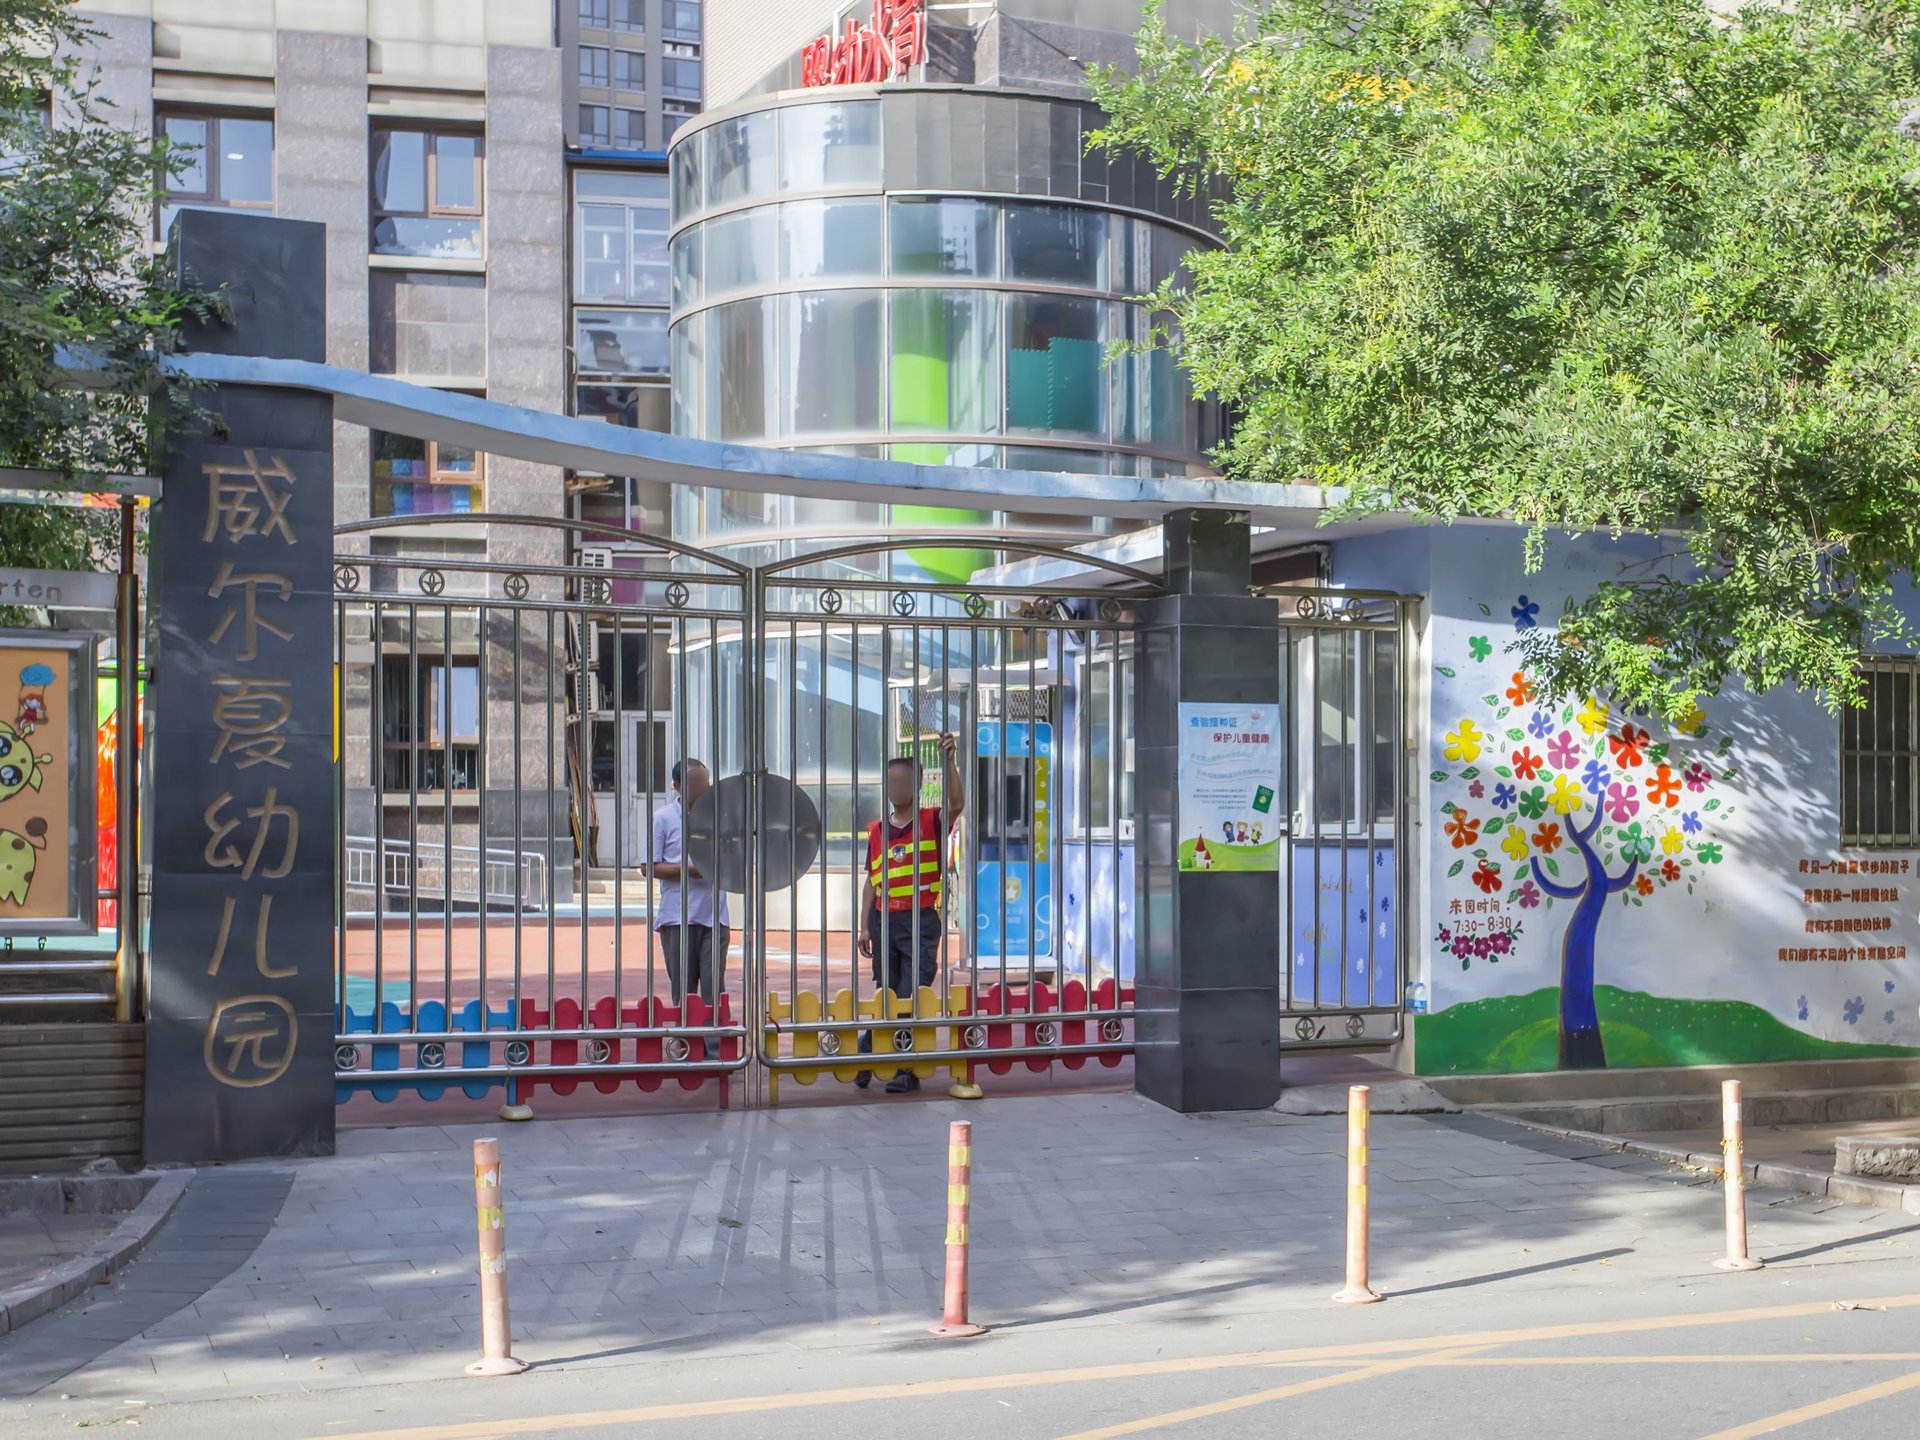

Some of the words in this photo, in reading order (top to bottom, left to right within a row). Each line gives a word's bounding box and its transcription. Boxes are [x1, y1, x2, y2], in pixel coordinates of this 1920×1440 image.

[1190, 717, 1238, 728] 查验接种证
[1213, 733, 1270, 744] 保护儿童健康
[202, 449, 299, 1088] 威尔夏幼儿园
